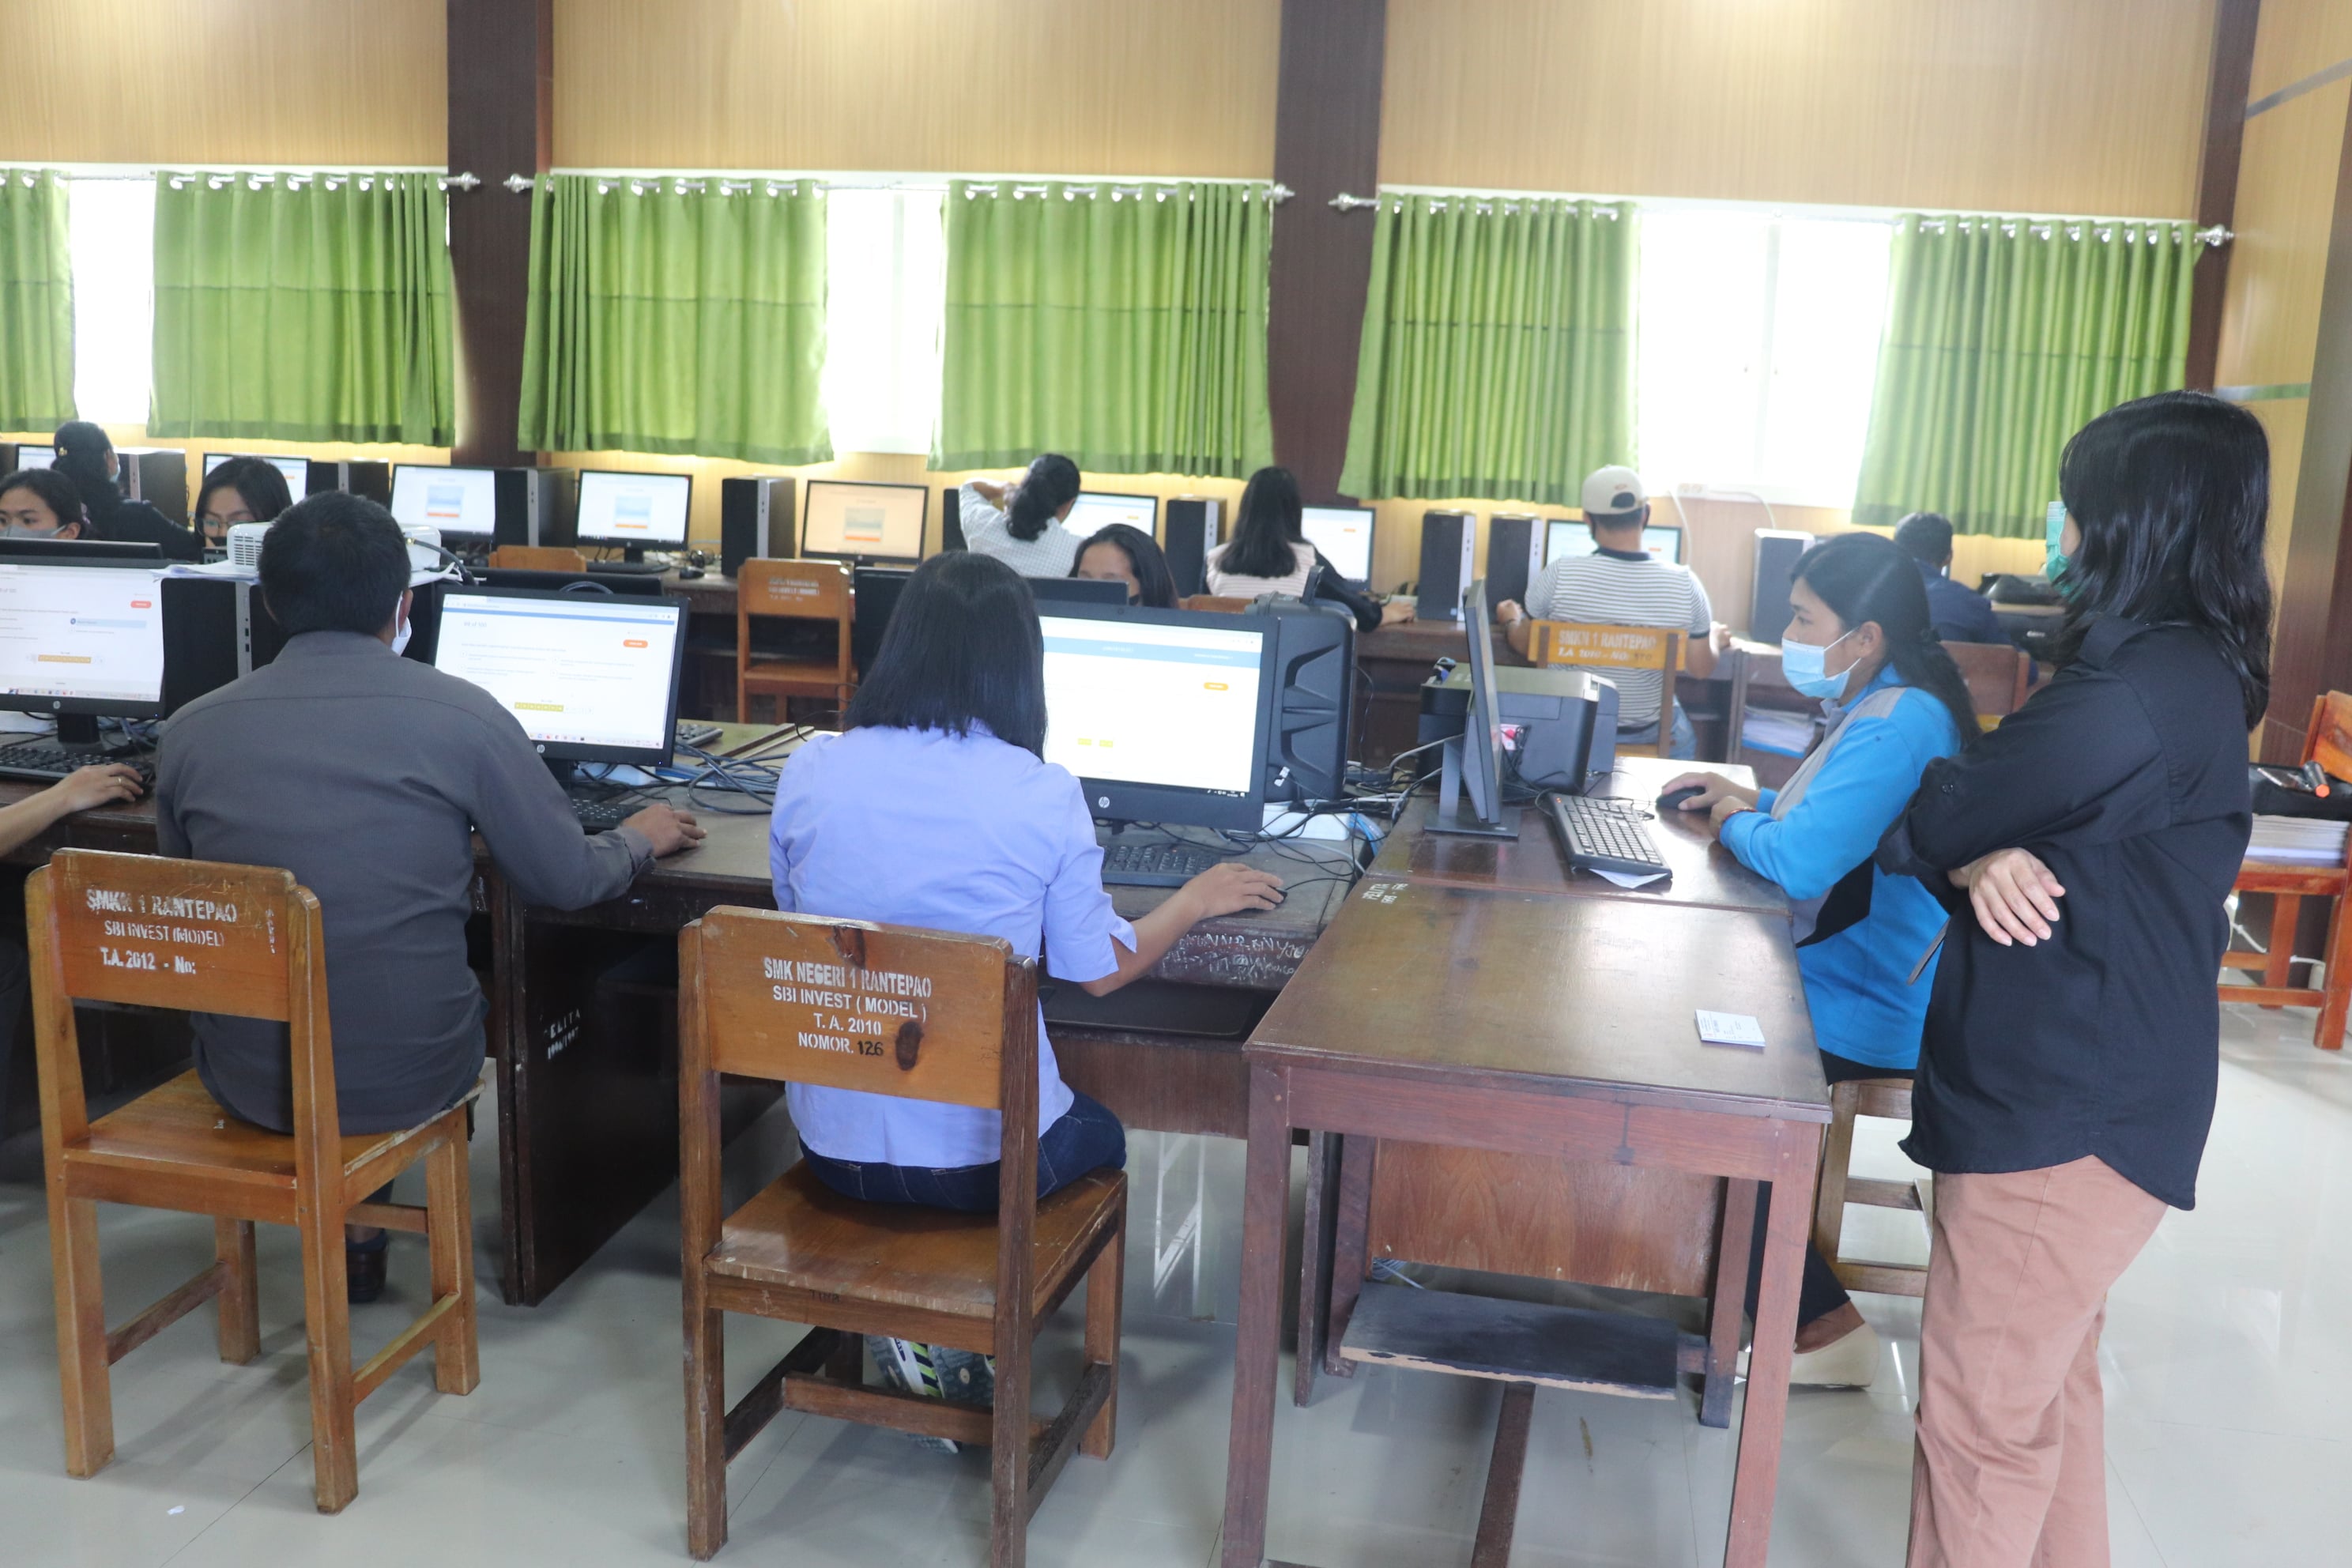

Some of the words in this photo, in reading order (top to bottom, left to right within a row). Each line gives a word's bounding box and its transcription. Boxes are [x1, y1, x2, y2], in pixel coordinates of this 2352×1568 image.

[86, 888, 133, 912] SMKN
[138, 894, 145, 914] 1
[152, 895, 237, 922] RANTEPAO
[104, 920, 126, 937] SBI
[127, 923, 169, 942] INVEST
[763, 957, 793, 981] SMK
[797, 961, 846, 987] NEGERI
[850, 968, 856, 989] 1
[861, 969, 932, 998] RANTEPAO
[773, 986, 797, 1002] SBI
[801, 989, 852, 1009] INVEST
[848, 1017, 882, 1035] 2010
[858, 1040, 884, 1057] 126
